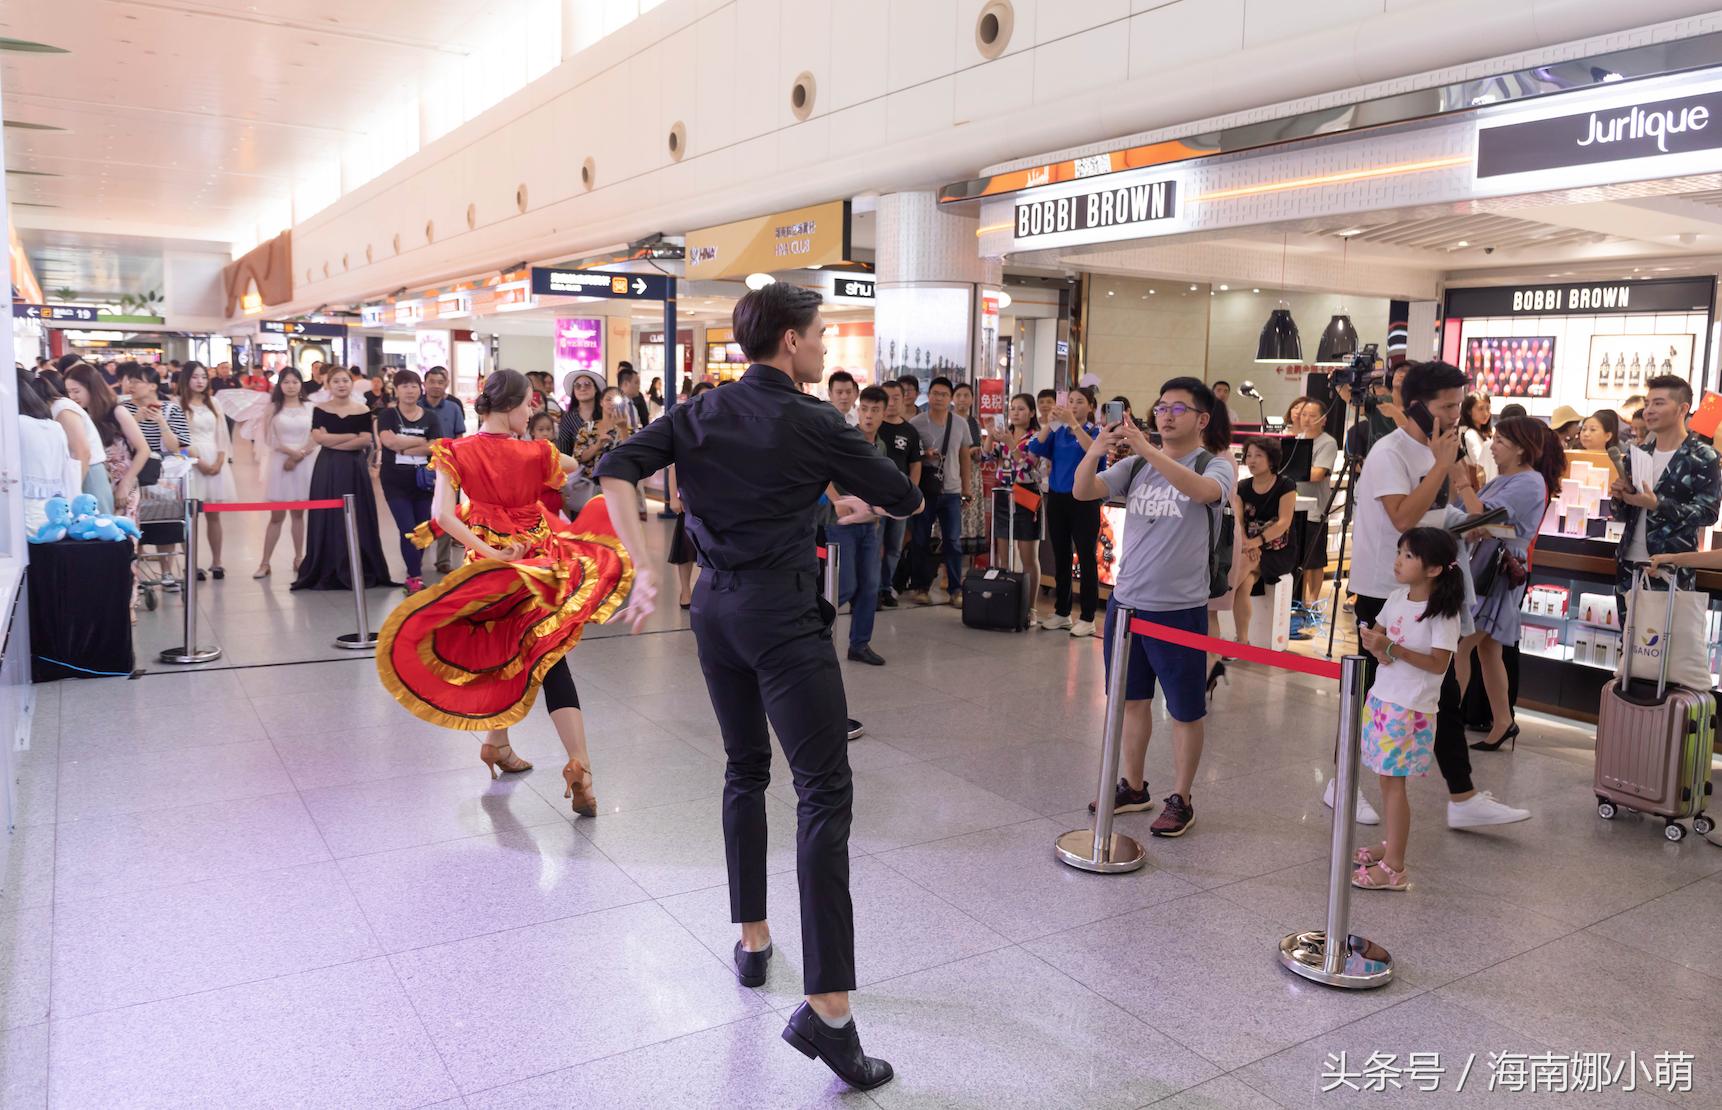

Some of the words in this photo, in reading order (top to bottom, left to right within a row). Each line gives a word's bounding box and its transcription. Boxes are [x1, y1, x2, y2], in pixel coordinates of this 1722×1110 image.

[1577, 105, 1709, 152] Jurlique
[1018, 197, 1077, 237] BOBBI
[1087, 182, 1166, 228] BROWN
[845, 281, 872, 297] shu
[1512, 289, 1562, 311] BOBBI
[1568, 286, 1630, 309] BROWN
[76, 309, 92, 320] 19
[980, 393, 1003, 410] 免税
[1631, 644, 1663, 658] SANO
